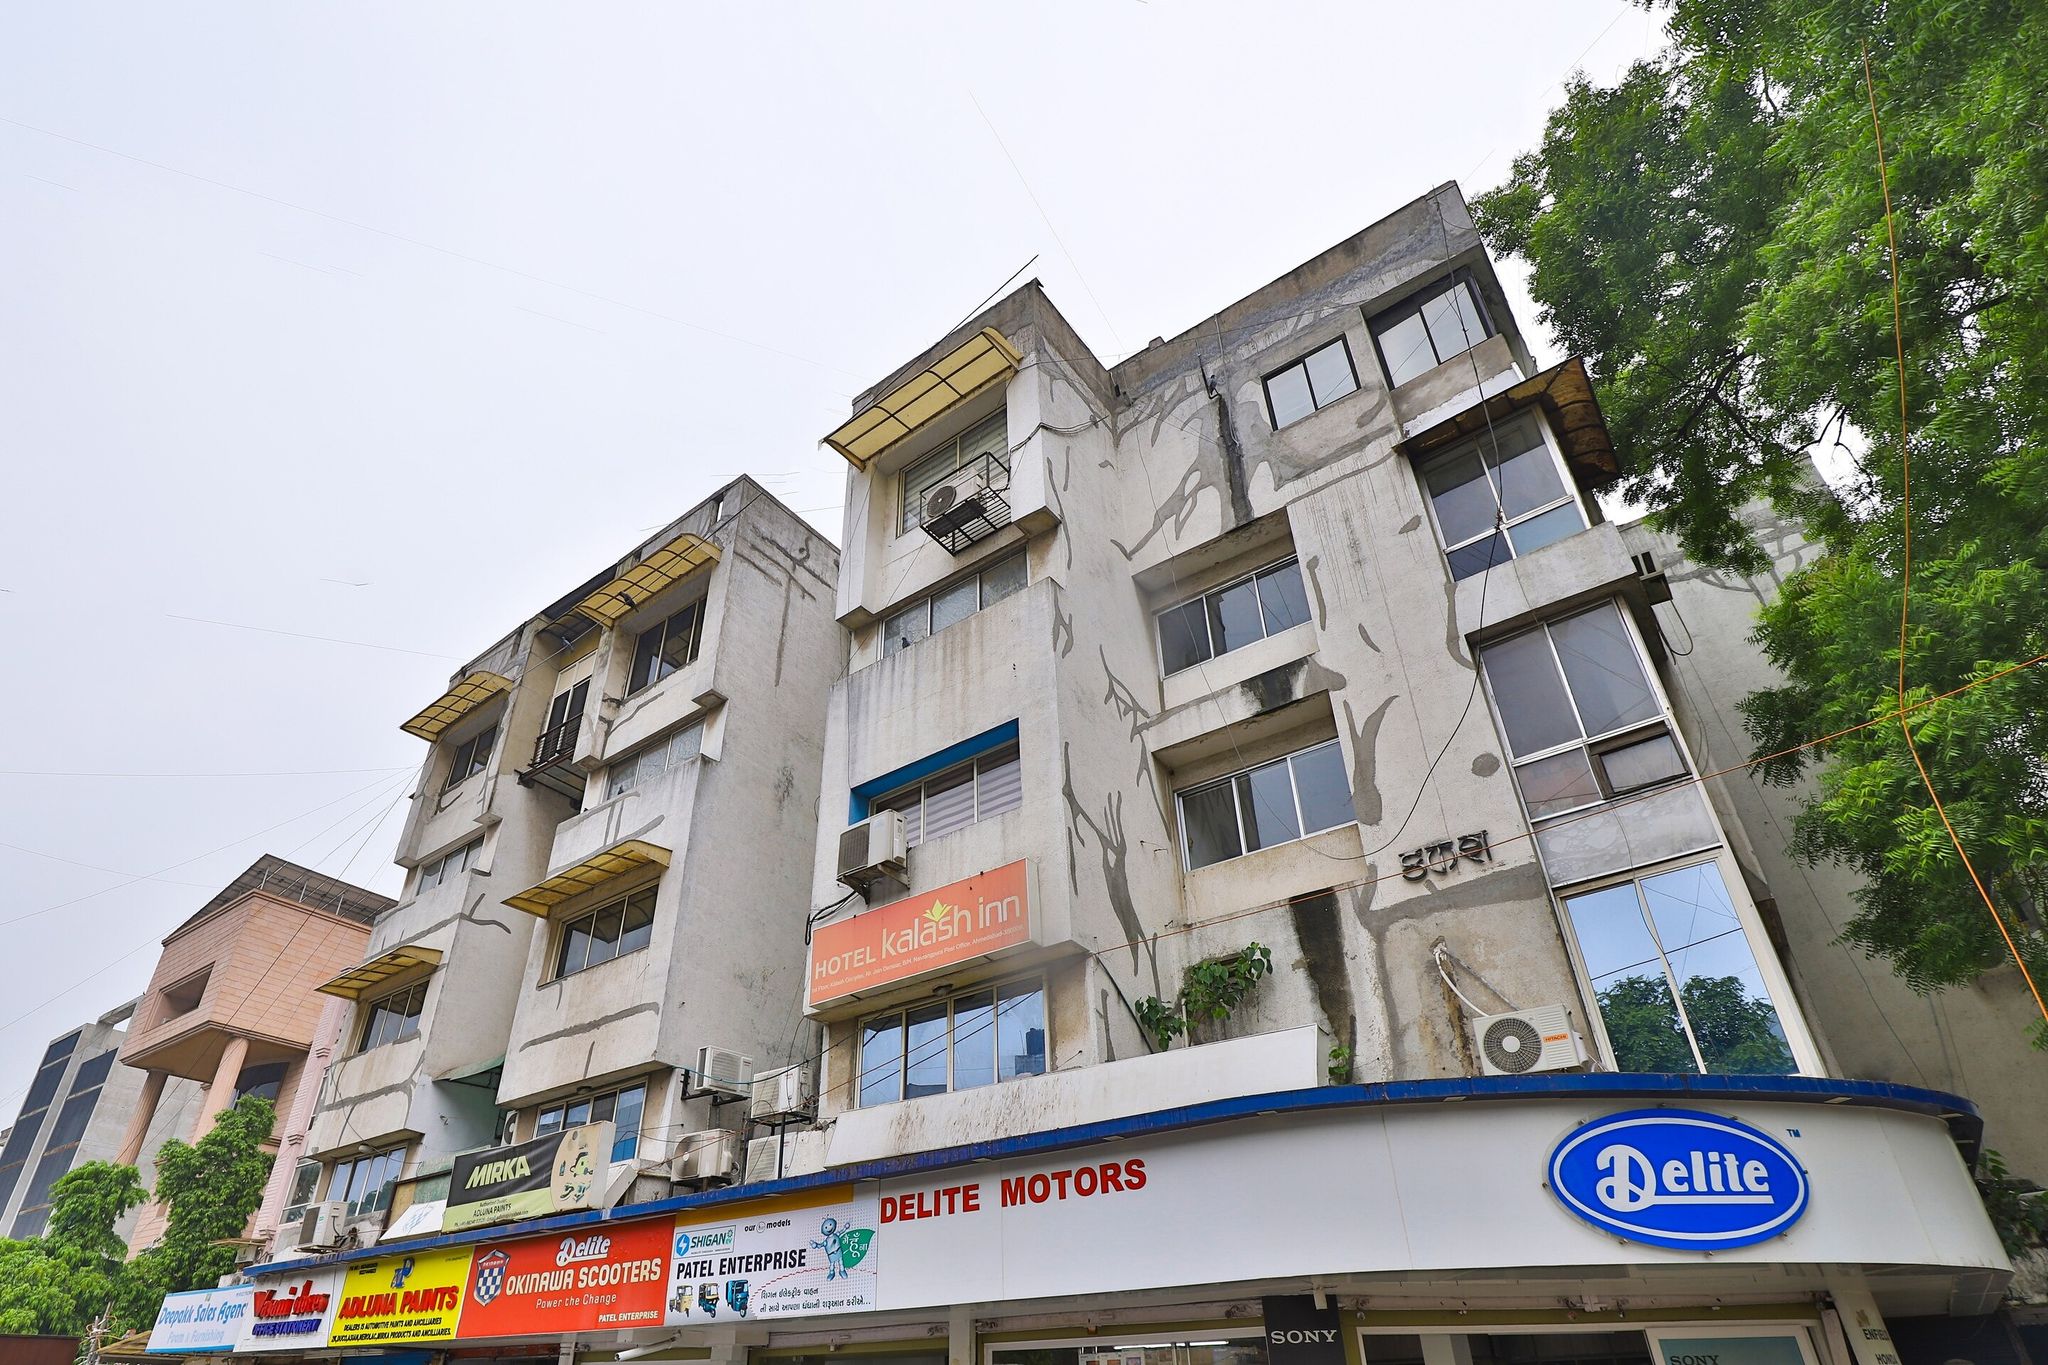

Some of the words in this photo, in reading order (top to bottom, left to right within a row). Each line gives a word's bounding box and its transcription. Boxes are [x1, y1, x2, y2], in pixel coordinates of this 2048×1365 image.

[815, 946, 877, 979] HOTEL
[979, 895, 1020, 930] inn
[1786, 1128, 1801, 1138] TM
[464, 1155, 532, 1190] MIRKA
[1596, 1144, 1775, 1213] Delite
[880, 1183, 980, 1224] DELITE
[1001, 1158, 1147, 1208] MOTORS
[473, 1207, 493, 1218] ADLUNA
[493, 1203, 512, 1214] PAINTS
[744, 1224, 756, 1233] our
[766, 1218, 791, 1230] models
[690, 1232, 727, 1248] SHIGAN
[556, 1235, 611, 1267] Delite
[676, 1259, 715, 1280] PATEL
[719, 1249, 807, 1276] ENTERPRISE
[506, 1268, 575, 1296] OKINAWA
[578, 1257, 662, 1289] SCOOTERS
[803, 1286, 819, 1296] વાહન
[338, 1292, 398, 1320] ADLUNA
[399, 1286, 459, 1315] PAINTS
[536, 1296, 562, 1309] Power
[564, 1296, 579, 1307] the
[582, 1293, 617, 1308] Change
[158, 1304, 194, 1329] Deepakk
[194, 1303, 217, 1322] Sales
[389, 1319, 403, 1328] PAINTS
[404, 1318, 413, 1327] AND
[598, 1313, 617, 1322] PATEL
[618, 1310, 659, 1321] ENTERPRISE
[167, 1331, 184, 1344] Foam
[191, 1328, 225, 1344] Furnishing
[389, 1330, 412, 1338] PRODUCTS
[412, 1329, 421, 1337] AND
[1270, 1329, 1338, 1344] SONY
[1670, 1354, 1720, 1365] SONY
